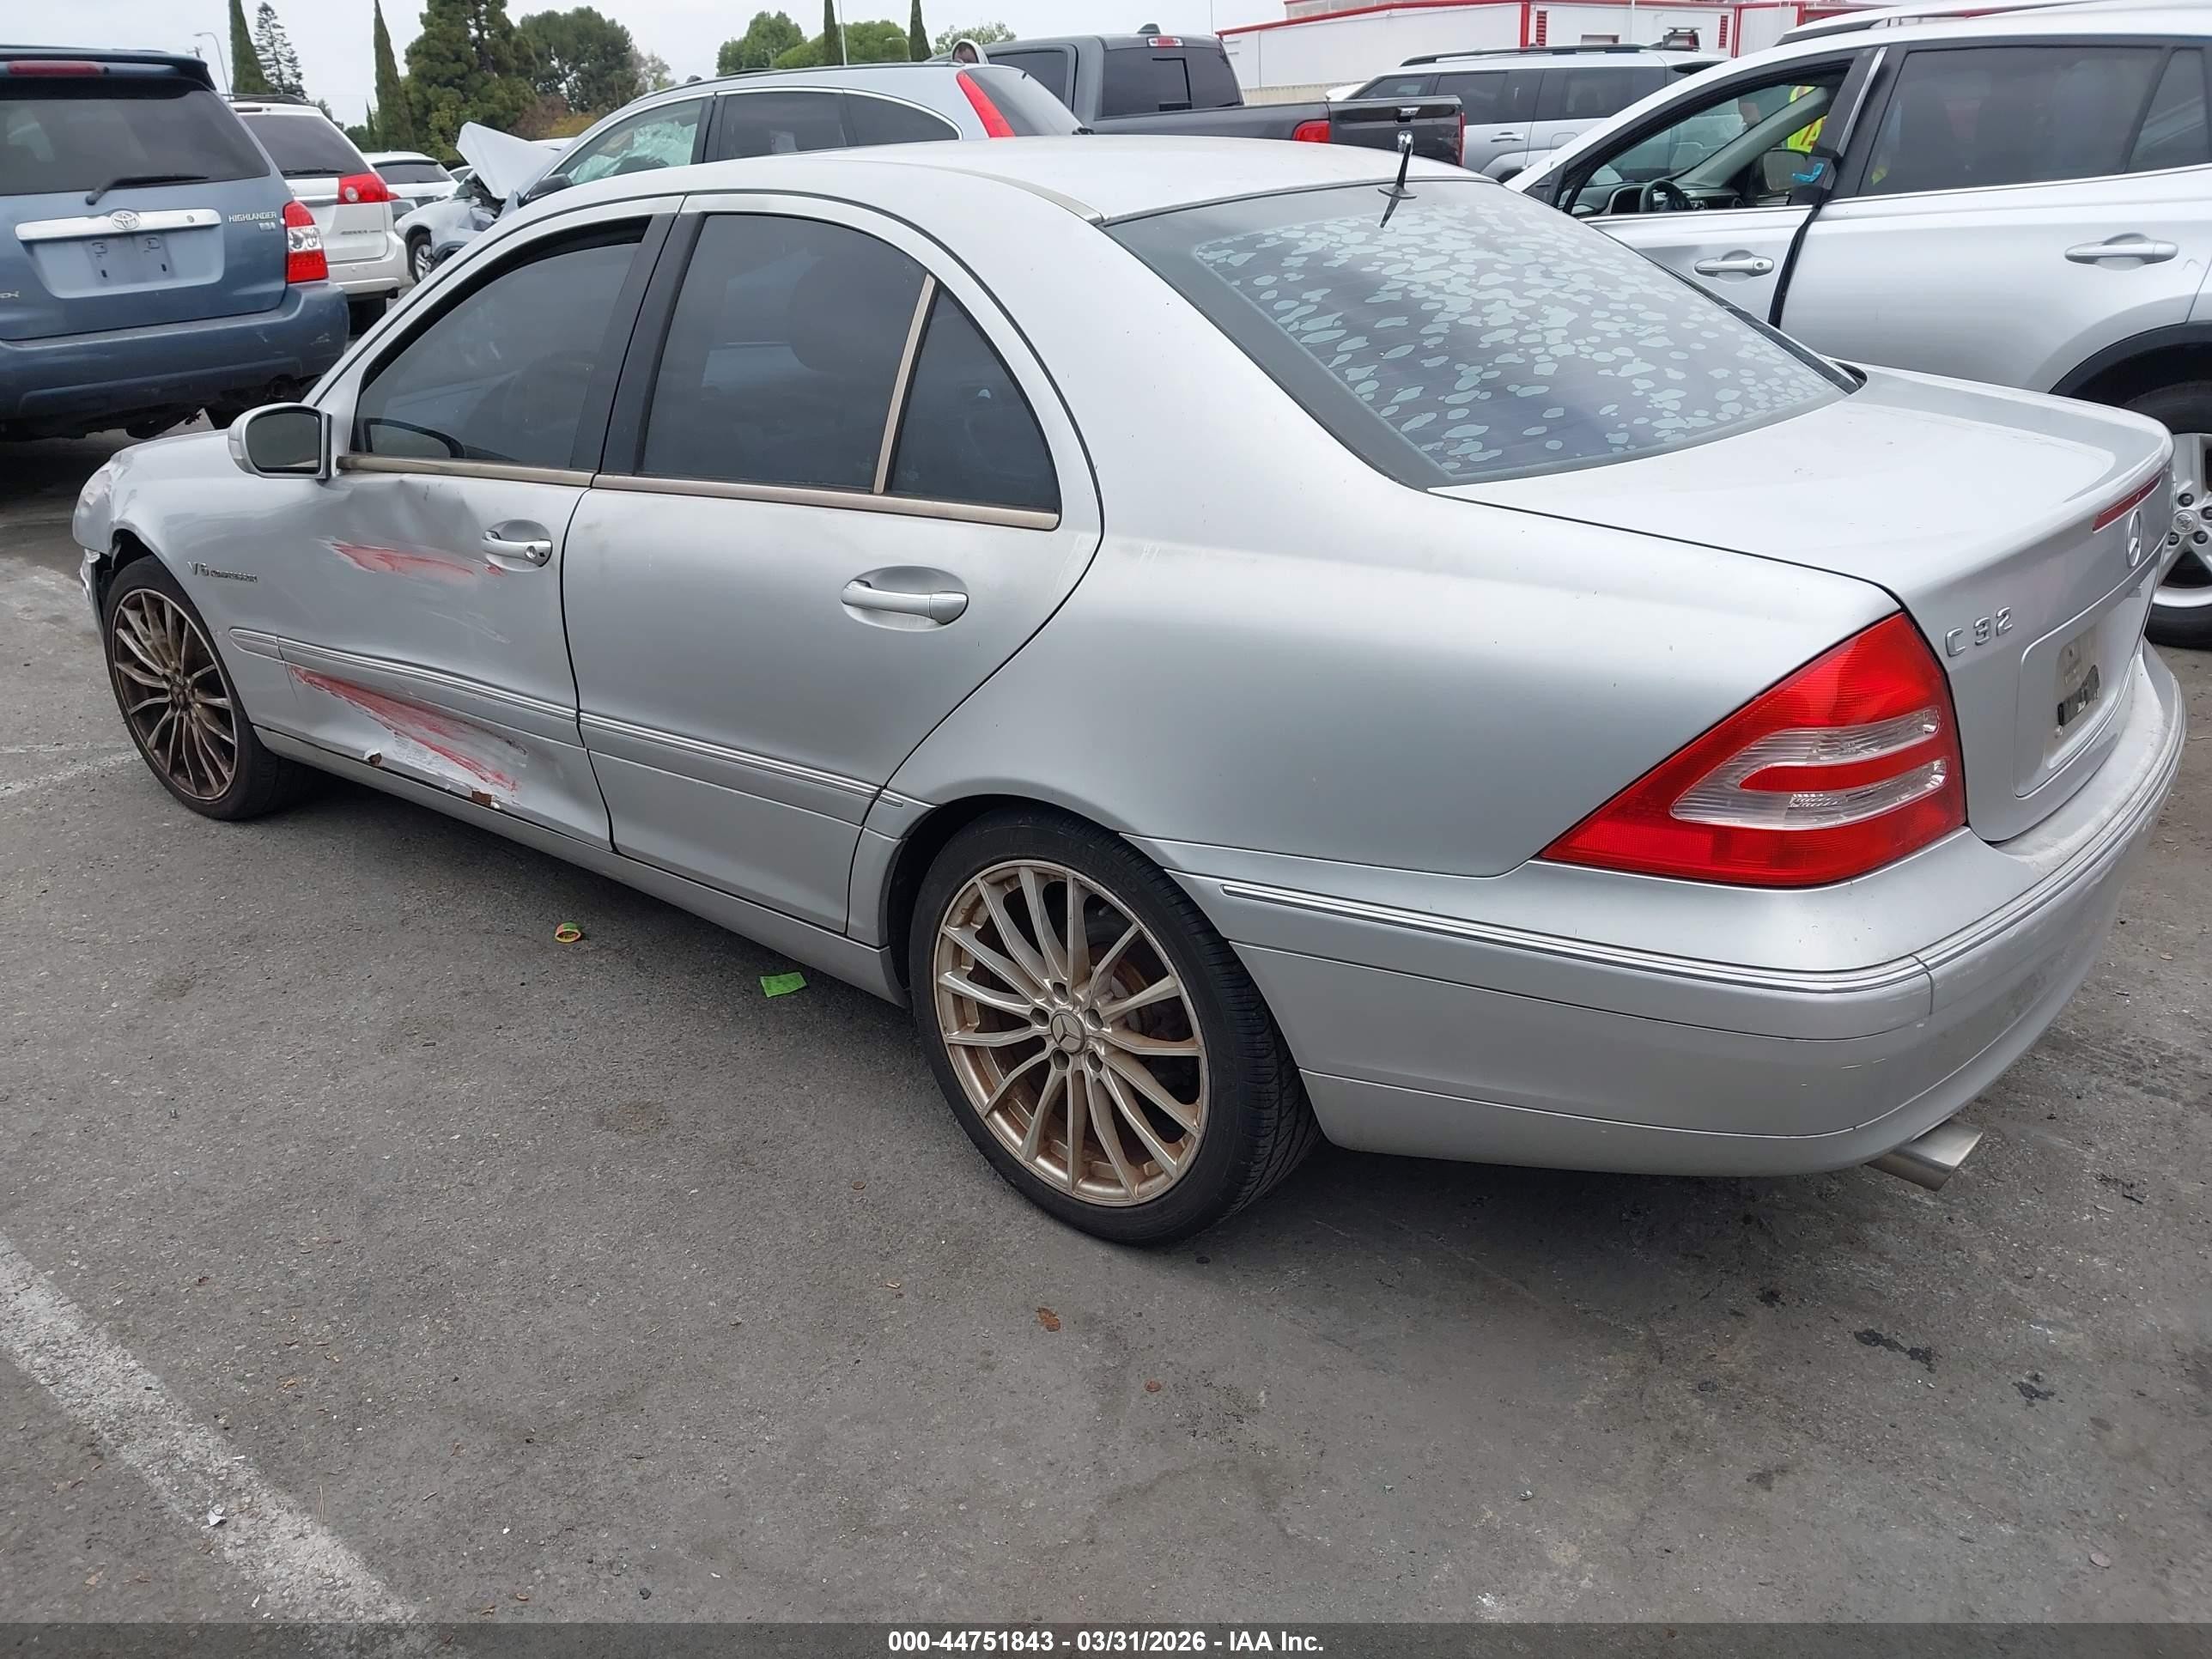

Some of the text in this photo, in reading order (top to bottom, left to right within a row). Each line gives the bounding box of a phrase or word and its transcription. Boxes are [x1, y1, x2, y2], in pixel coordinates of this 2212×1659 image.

[228, 211, 276, 222] HIGHLANDER
[1945, 606, 2013, 659] C 32
